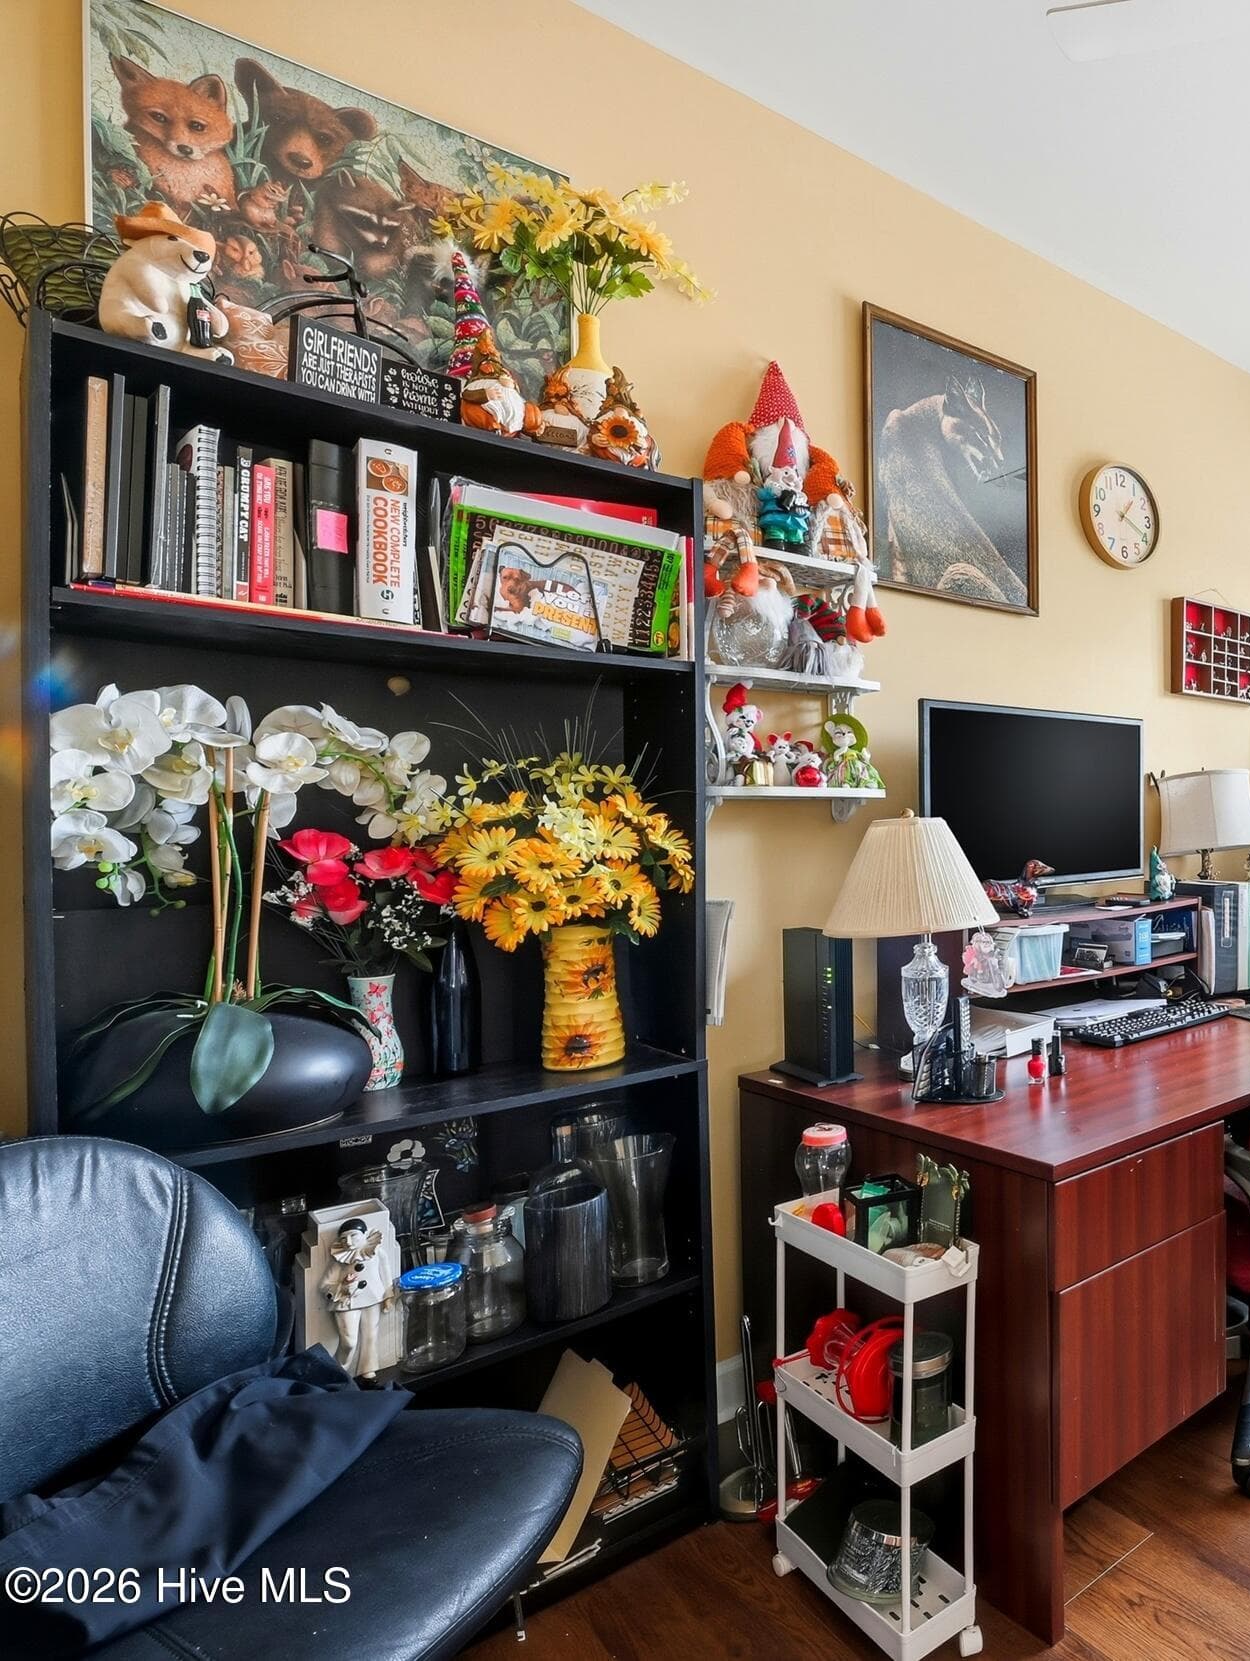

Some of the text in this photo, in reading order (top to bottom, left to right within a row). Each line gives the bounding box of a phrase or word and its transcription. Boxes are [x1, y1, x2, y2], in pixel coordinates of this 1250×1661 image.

[303, 326, 378, 375] GIRLFRIENDS
[301, 351, 377, 391] ARE JUST THERAPISTS
[301, 367, 376, 404] YOU CAN DRINK WITH
[1114, 472, 1126, 488] 12
[1095, 486, 1106, 501] 10
[239, 469, 250, 542] GRUMPY CAT
[1093, 503, 1101, 517] 9
[1140, 497, 1147, 511] 2
[1144, 515, 1151, 529] 3
[372, 496, 388, 586] COOKBOOK
[390, 499, 401, 588] NEW COMPLETE
[1107, 537, 1115, 550] 7
[1121, 545, 1128, 559] 6
